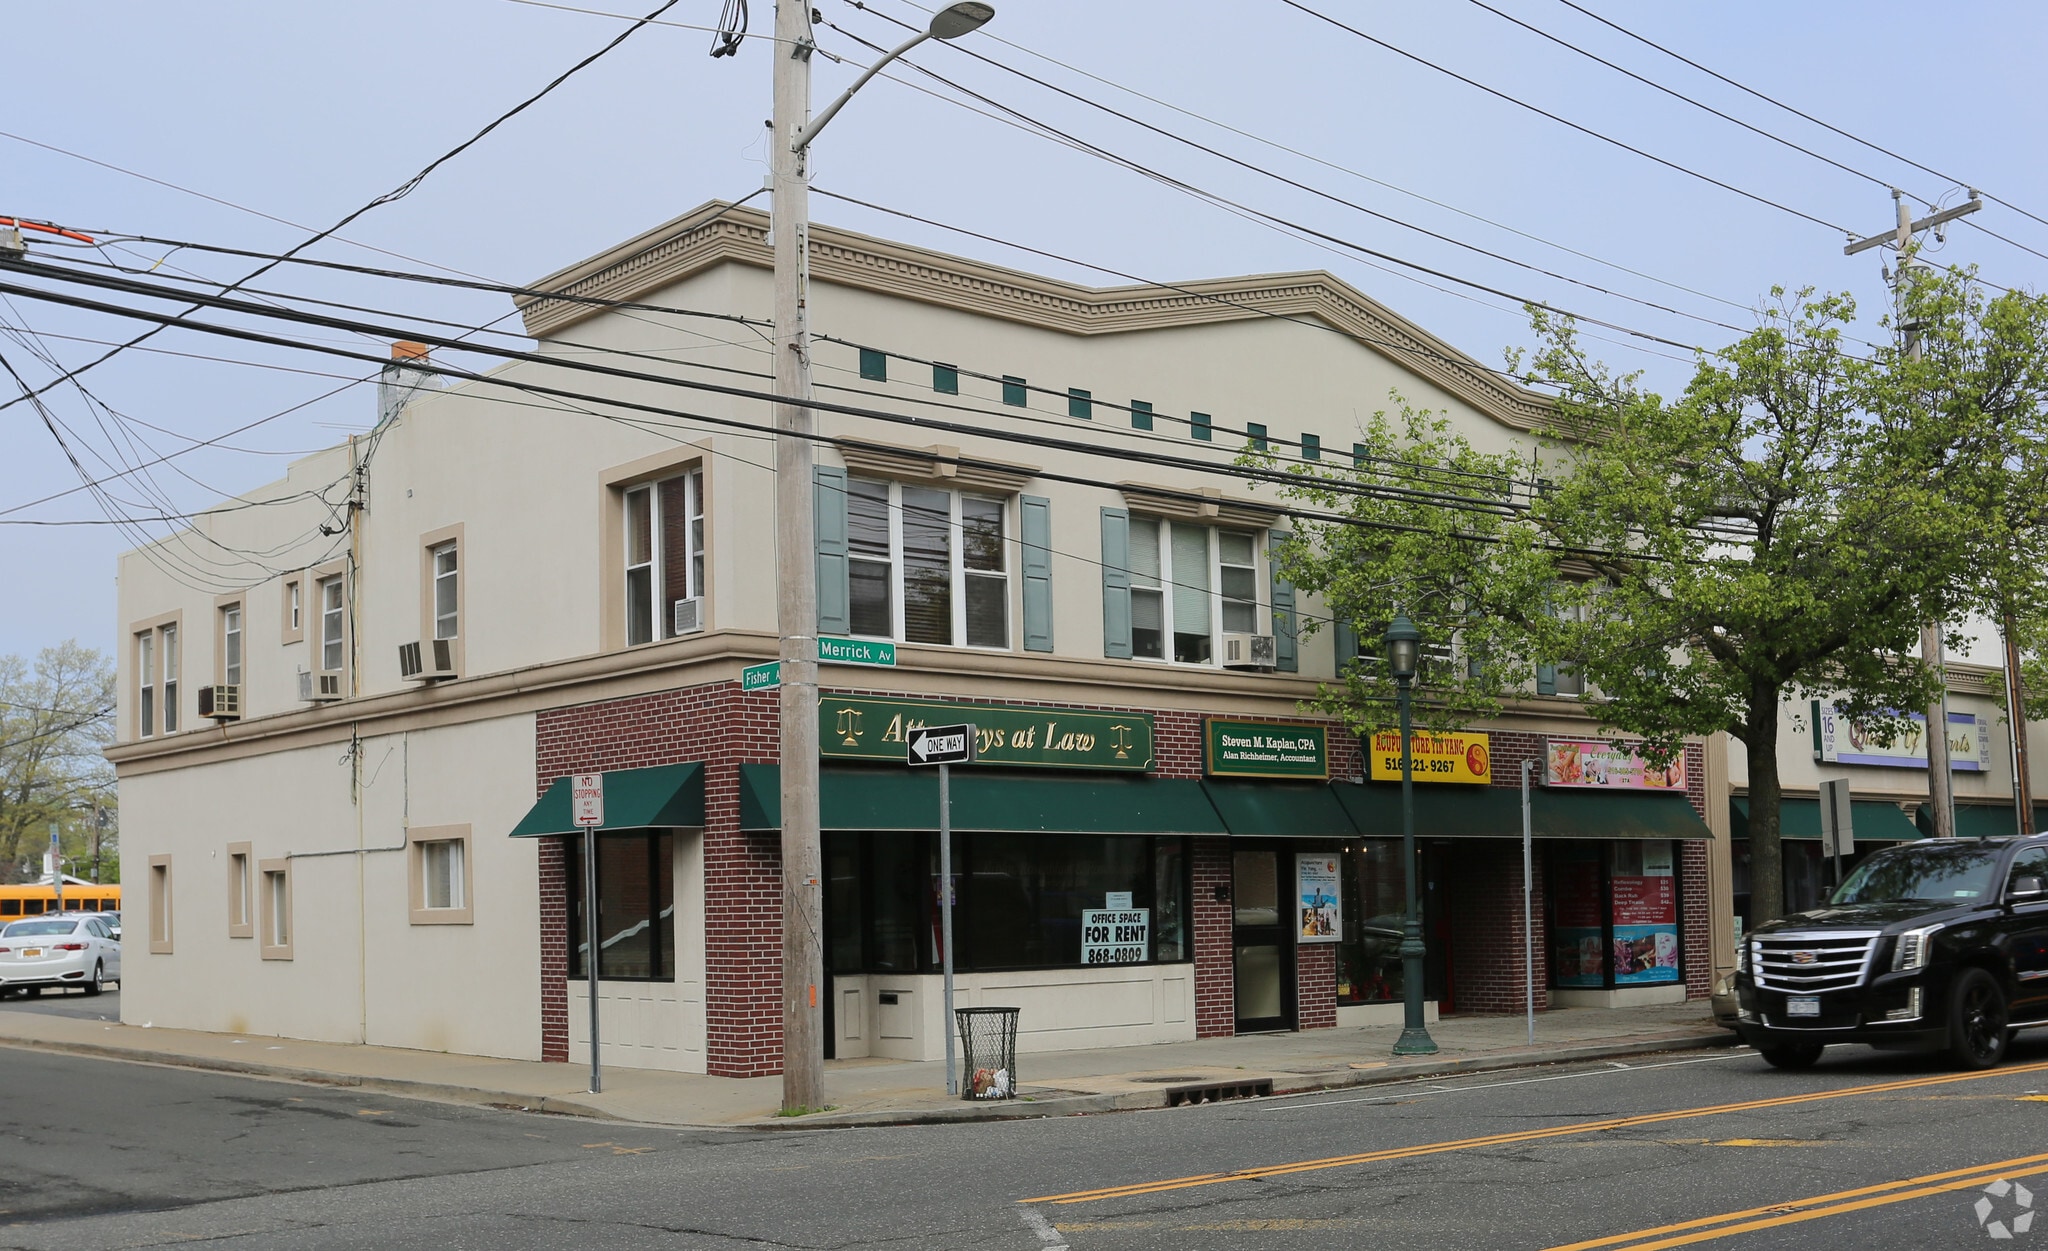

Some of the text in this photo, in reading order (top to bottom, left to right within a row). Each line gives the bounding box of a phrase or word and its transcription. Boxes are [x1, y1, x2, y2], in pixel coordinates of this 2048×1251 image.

[821, 641, 891, 661] Merrick Av
[746, 671, 770, 686] Fisher
[1821, 706, 1834, 716] SIZES
[1822, 715, 1835, 734] 16
[927, 735, 962, 753] ONE WAY
[1011, 724, 1036, 749] at
[1043, 721, 1096, 752] Law
[1222, 734, 1252, 748] Steven
[1253, 736, 1265, 748] M.
[1297, 738, 1316, 751] CPA
[1823, 734, 1835, 743] AND
[1375, 733, 1465, 756] ACUPUTURE YIN YANG
[1825, 743, 1834, 752] UP
[1223, 750, 1317, 763] Alan Richheimer, Accountant
[581, 776, 593, 787] NO
[575, 788, 601, 799] STOPPING
[1091, 912, 1141, 924] OFFICE SPACE
[1085, 925, 1146, 943] FOR RENT
[1088, 947, 1142, 963] 868-0809
